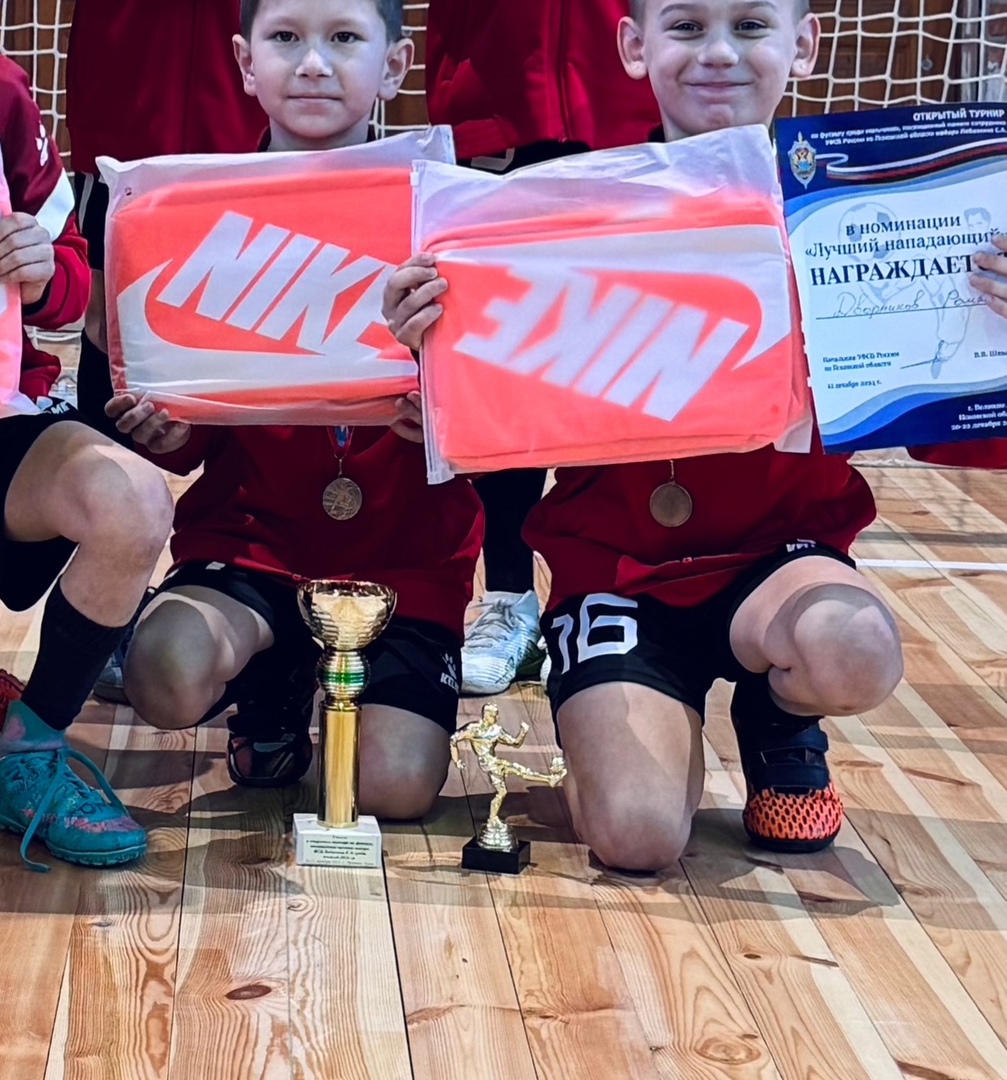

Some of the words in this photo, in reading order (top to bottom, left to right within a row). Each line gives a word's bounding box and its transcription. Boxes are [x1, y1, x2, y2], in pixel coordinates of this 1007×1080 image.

[912, 107, 967, 121] ОТКРЫТЫЙ
[968, 108, 1005, 118] ТУРНИР
[846, 224, 855, 236] в
[860, 215, 962, 236] номинации
[805, 238, 880, 260] «Лучший
[885, 228, 1007, 252] нападающий
[810, 253, 990, 286] НАГРАЖДАЕТ
[452, 267, 751, 422] NIKE
[550, 592, 638, 675] 16
